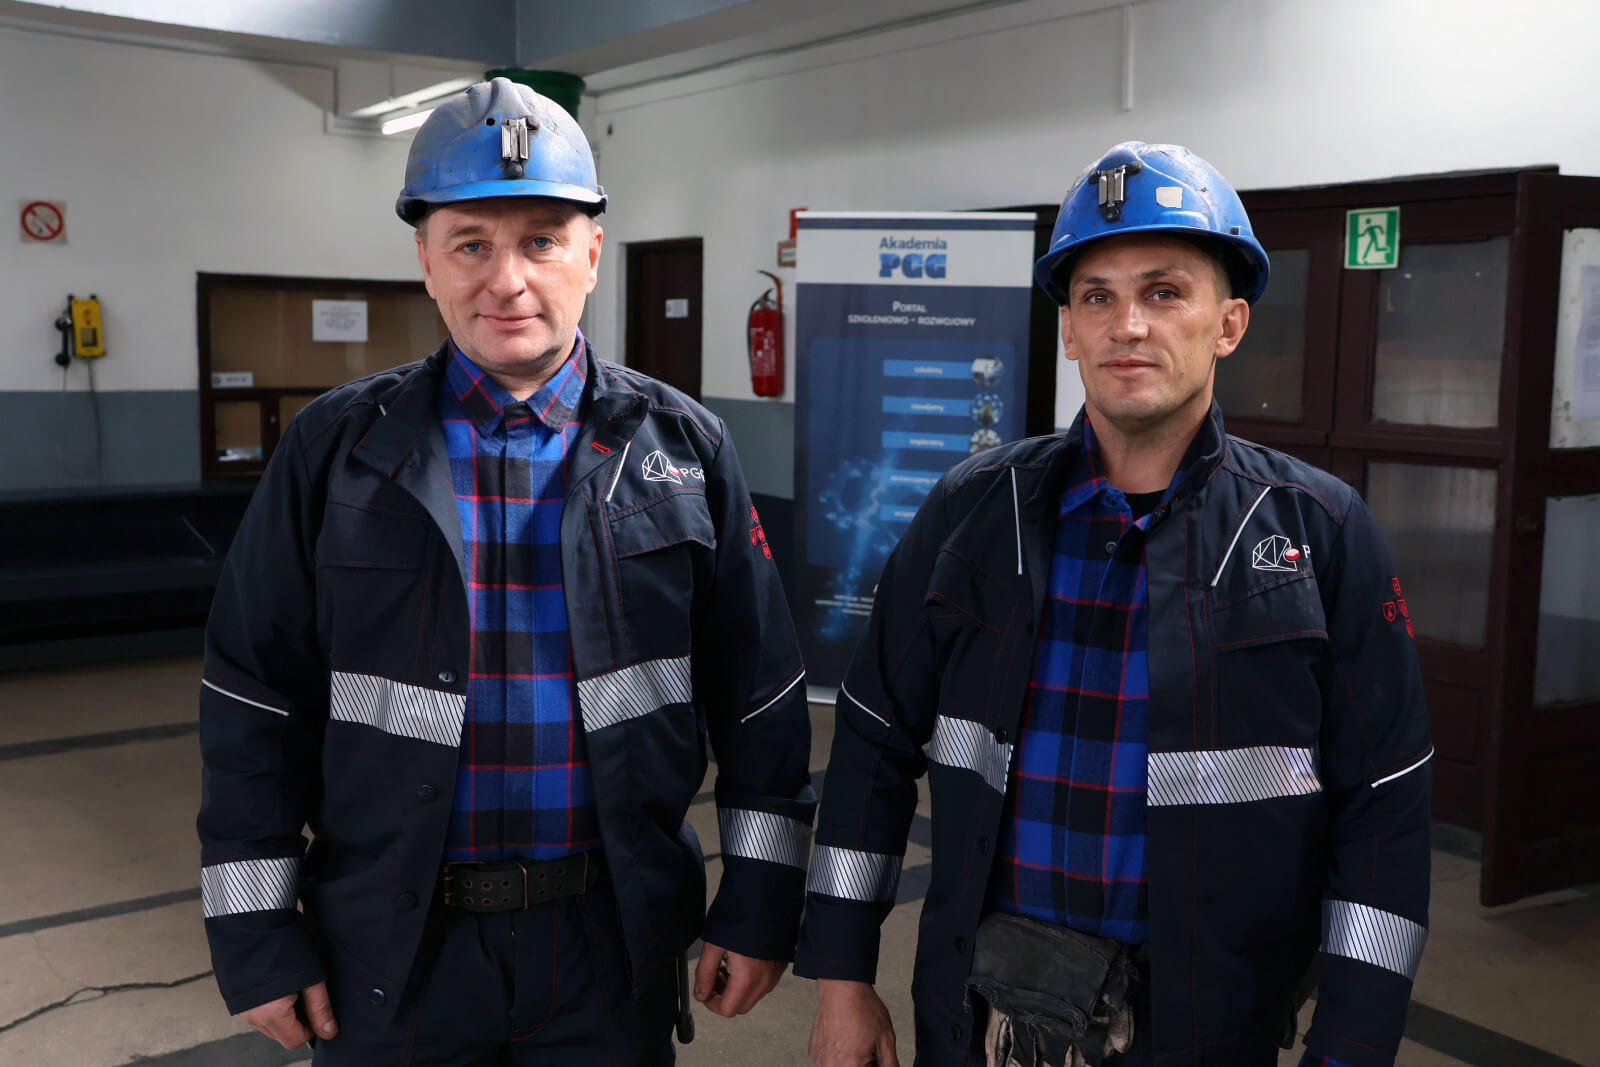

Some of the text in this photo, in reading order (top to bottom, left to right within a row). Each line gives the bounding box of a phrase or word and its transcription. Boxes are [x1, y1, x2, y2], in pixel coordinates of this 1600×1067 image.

[879, 235, 948, 250] Akademia
[879, 252, 947, 279] PGG
[847, 314, 909, 325] SZKOLENIOWO
[917, 315, 976, 327] ROZWOJOWY
